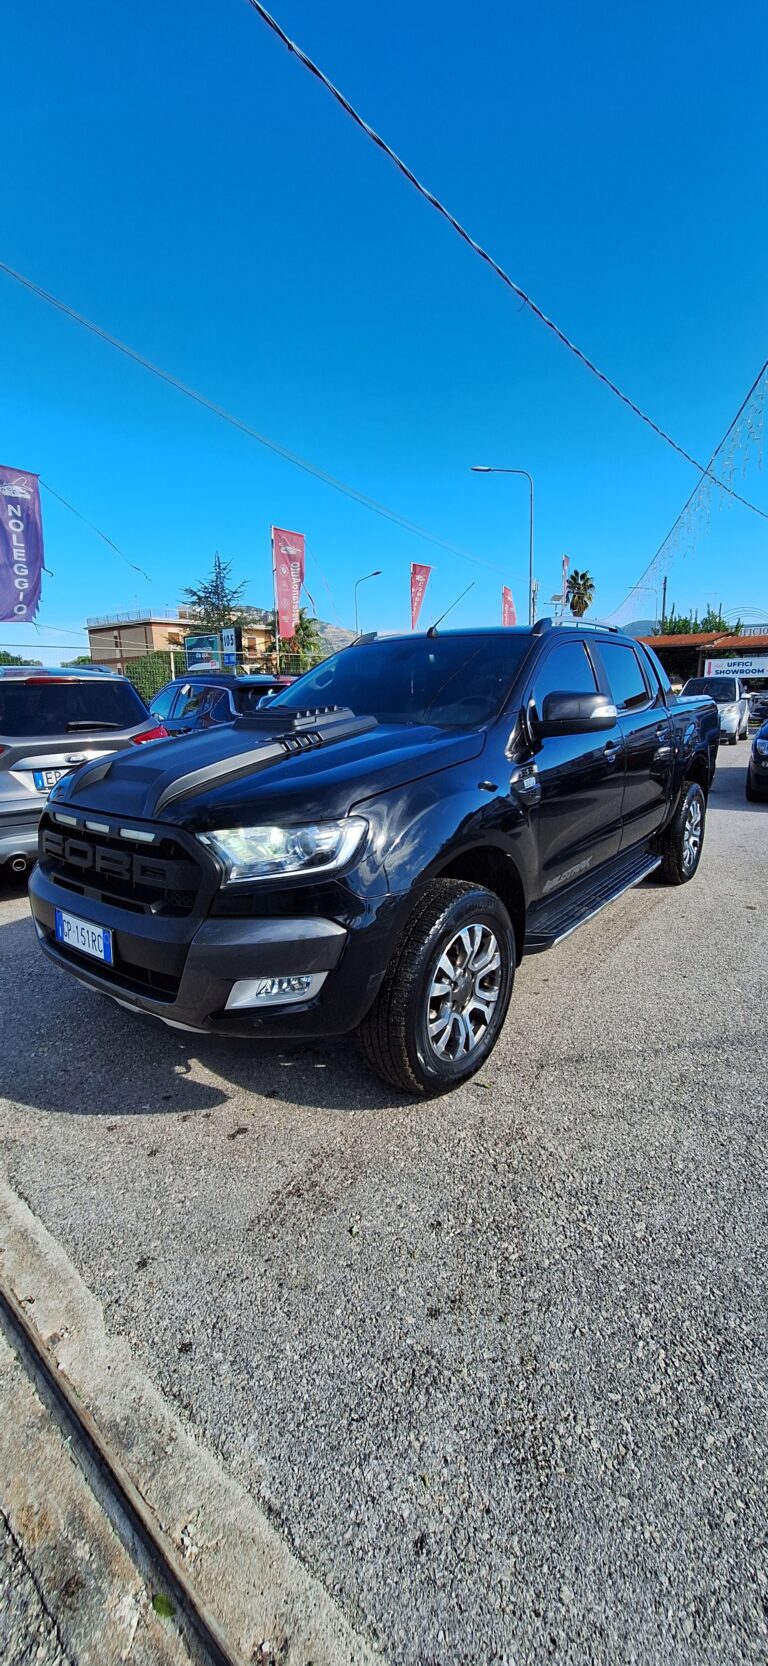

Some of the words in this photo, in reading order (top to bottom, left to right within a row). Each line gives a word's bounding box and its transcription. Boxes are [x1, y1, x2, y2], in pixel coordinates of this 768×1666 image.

[7, 504, 29, 615] NOLEGGIO
[714, 668, 765, 676] SHOWROOM
[41, 829, 176, 886] FORD
